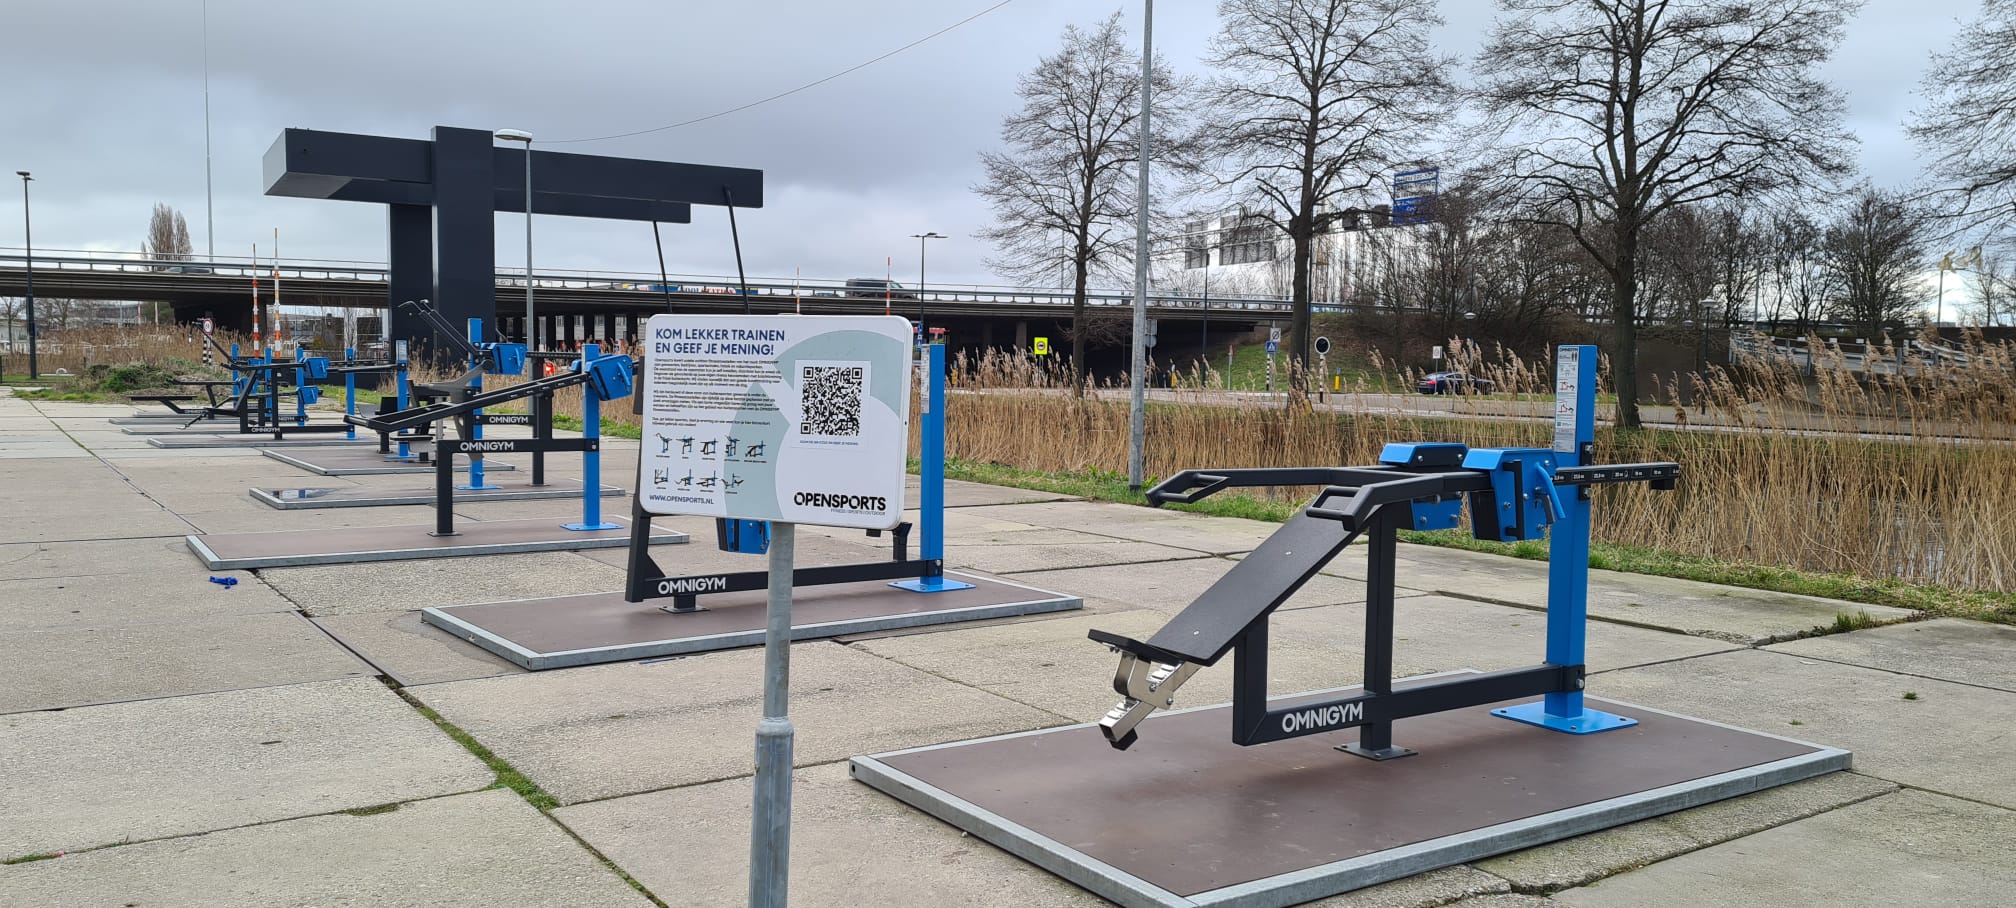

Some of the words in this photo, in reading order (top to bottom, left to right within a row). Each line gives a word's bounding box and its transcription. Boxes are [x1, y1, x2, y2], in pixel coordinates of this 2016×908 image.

[655, 328, 682, 340] KOM
[685, 329, 729, 341] LEKKER
[732, 329, 785, 341] TRAINEN
[655, 342, 671, 353] EN
[673, 343, 703, 354] GEEF
[704, 343, 718, 354] JE
[721, 344, 774, 355] MENING!
[489, 416, 529, 424] OMNIGYM
[460, 441, 514, 451] OMNIGYM
[649, 494, 714, 505] WWW.OPENSPORTS.NL
[793, 491, 887, 512] OPENSPORTS
[657, 577, 727, 595] OMNIGYM
[1281, 701, 1364, 733] OMNIGYM
